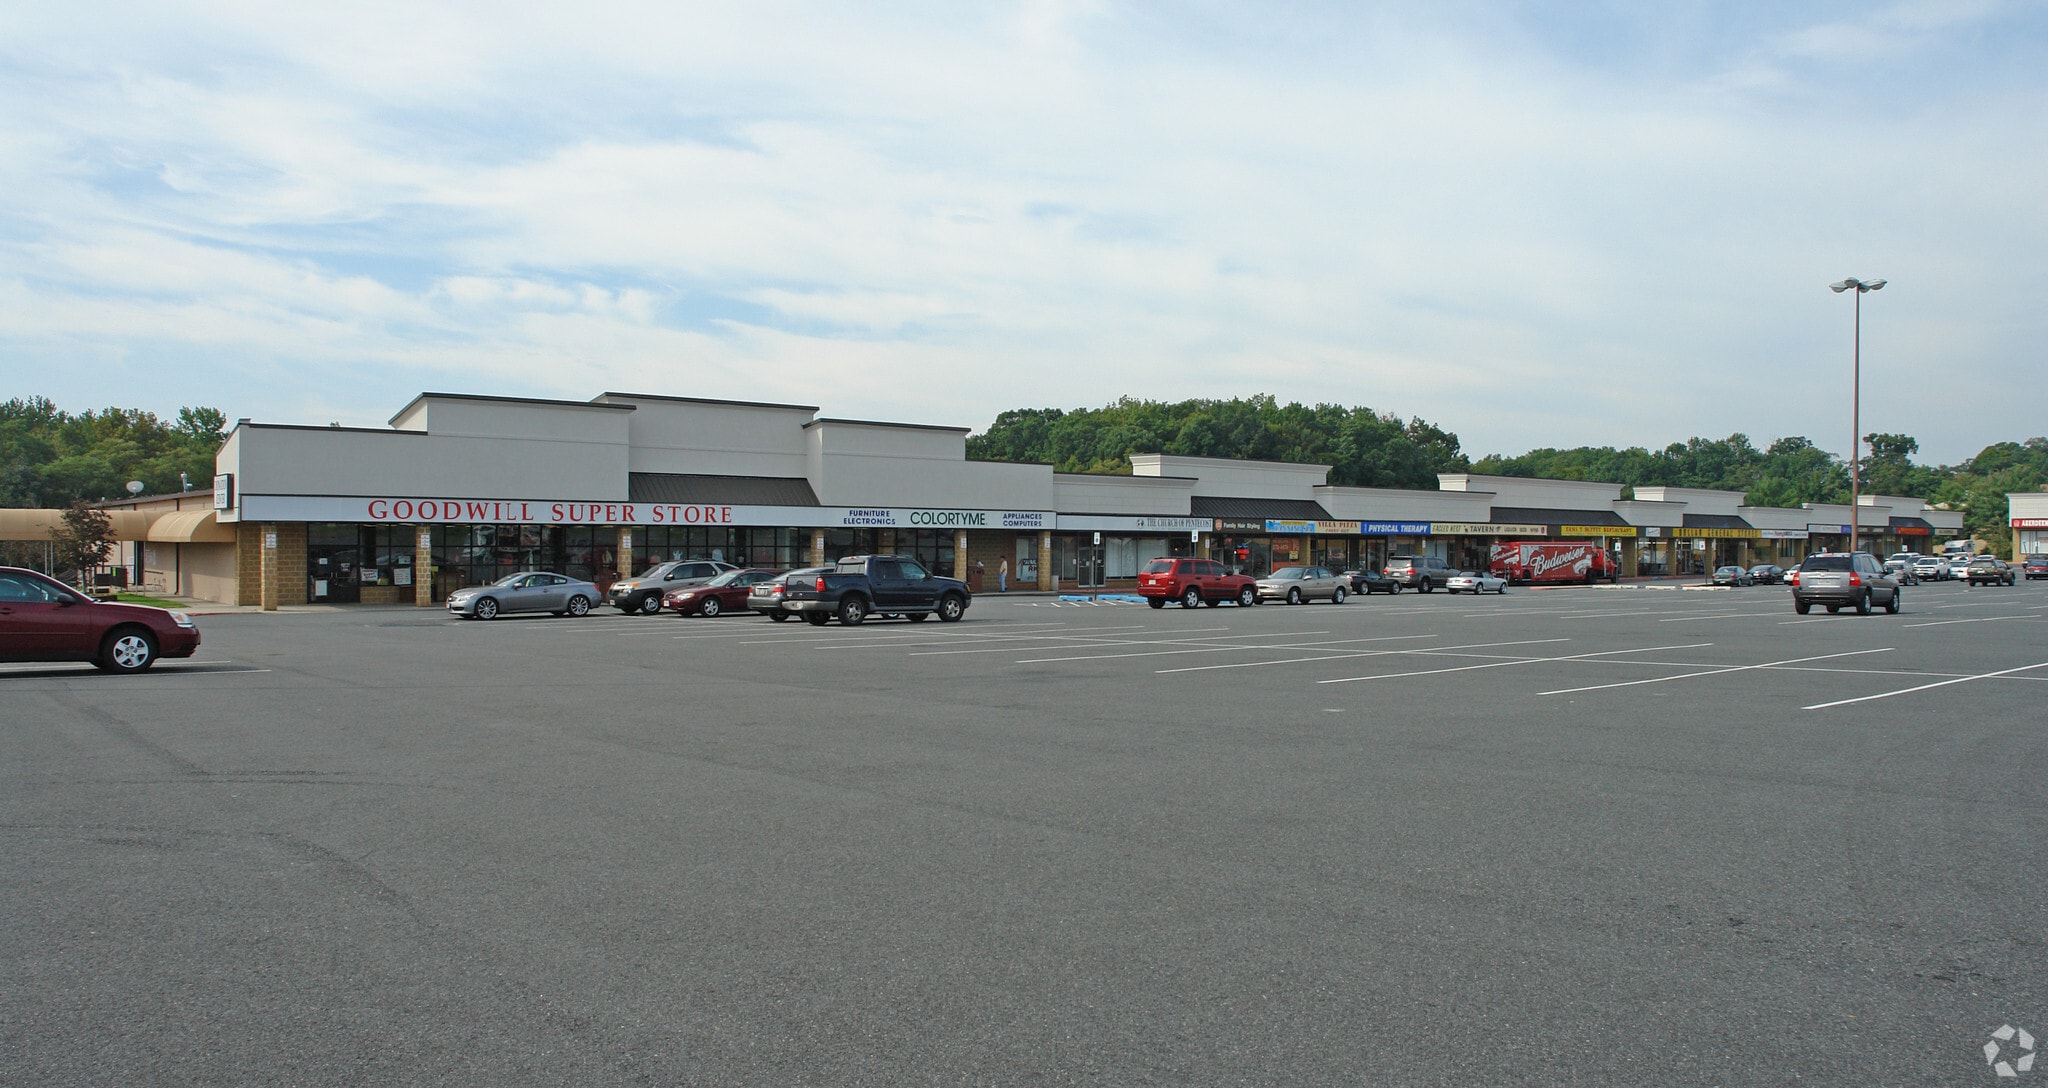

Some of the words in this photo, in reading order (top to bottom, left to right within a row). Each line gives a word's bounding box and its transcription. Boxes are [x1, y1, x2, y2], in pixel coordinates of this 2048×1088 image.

[368, 499, 534, 521] GOODWILL
[551, 503, 636, 522] SUPER
[652, 505, 732, 524] STORE
[843, 517, 896, 525] ELECTRONICS
[910, 511, 985, 526] COLORTYME
[1147, 518, 1157, 527] THE
[1157, 518, 1178, 527] CHURCH
[1178, 519, 1185, 527] OF
[1185, 519, 1212, 528] PENTECOST
[1368, 524, 1398, 532] PHYSICAL
[1400, 525, 1428, 533] THERAPY
[1470, 525, 1495, 533] TAVERN
[1530, 546, 1585, 576] Budweiser
